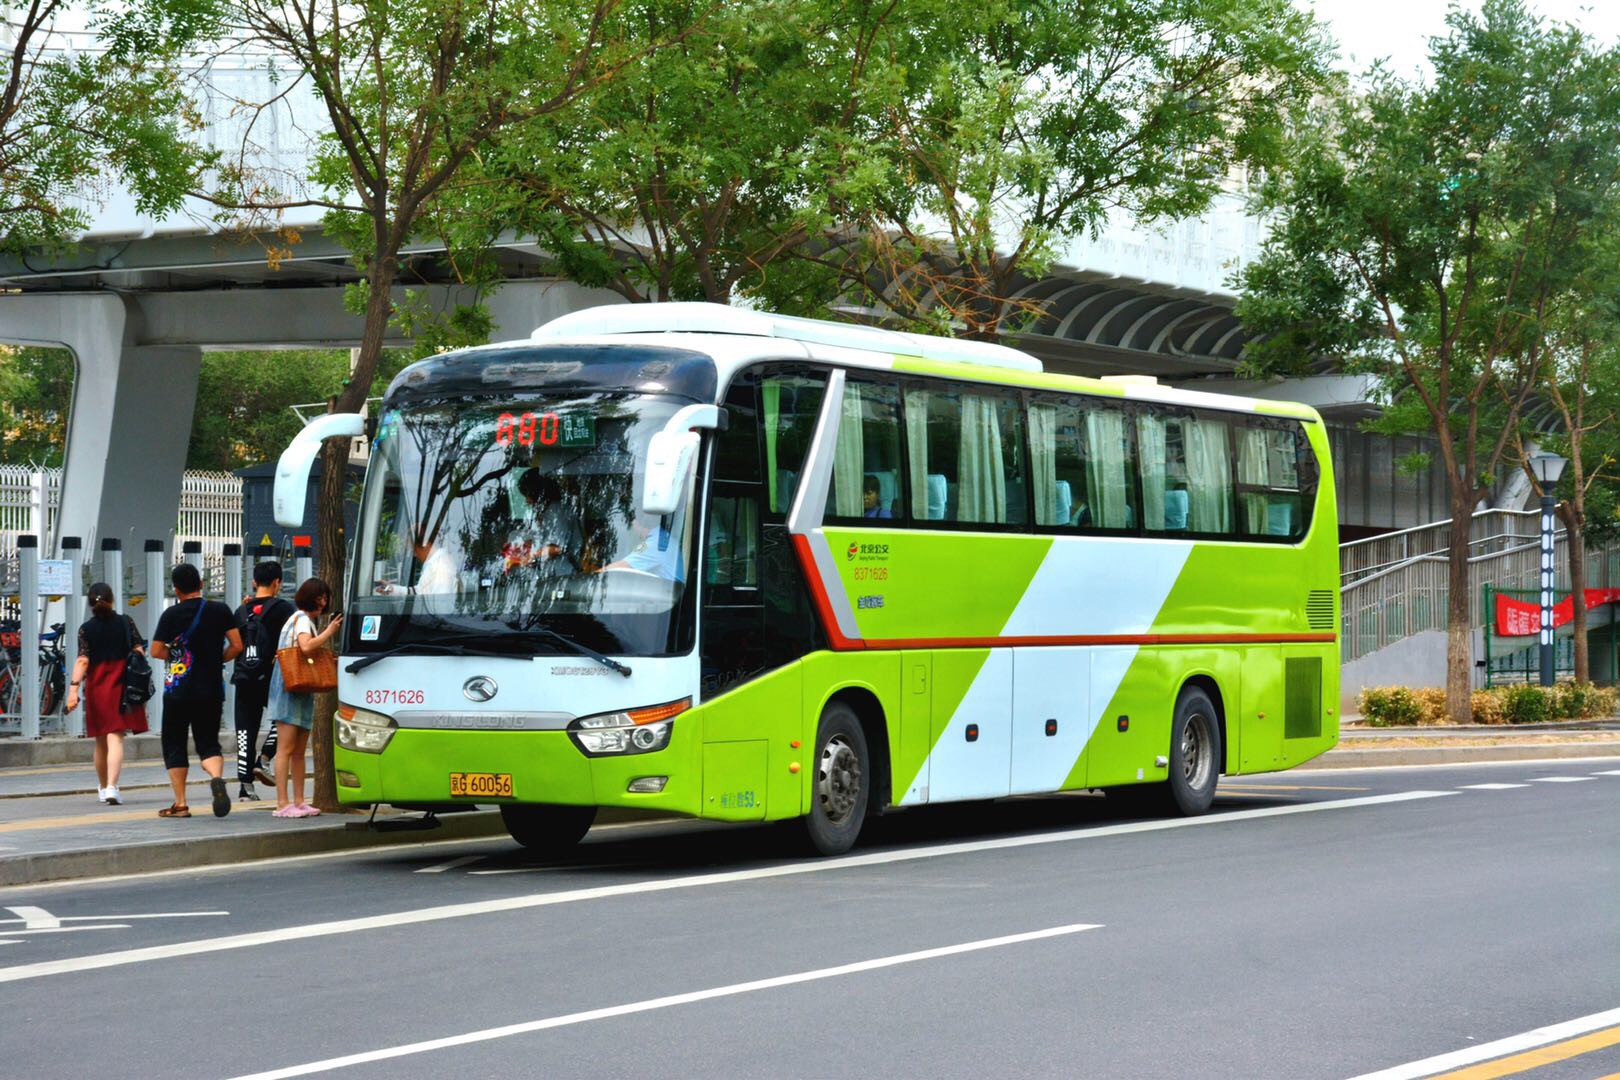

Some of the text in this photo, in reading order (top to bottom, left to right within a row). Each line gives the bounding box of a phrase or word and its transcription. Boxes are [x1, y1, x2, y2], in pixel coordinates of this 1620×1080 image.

[496, 412, 560, 446] 880
[860, 544, 889, 554] 北京公交
[854, 567, 888, 581] 8371626
[366, 690, 424, 704] 8371626
